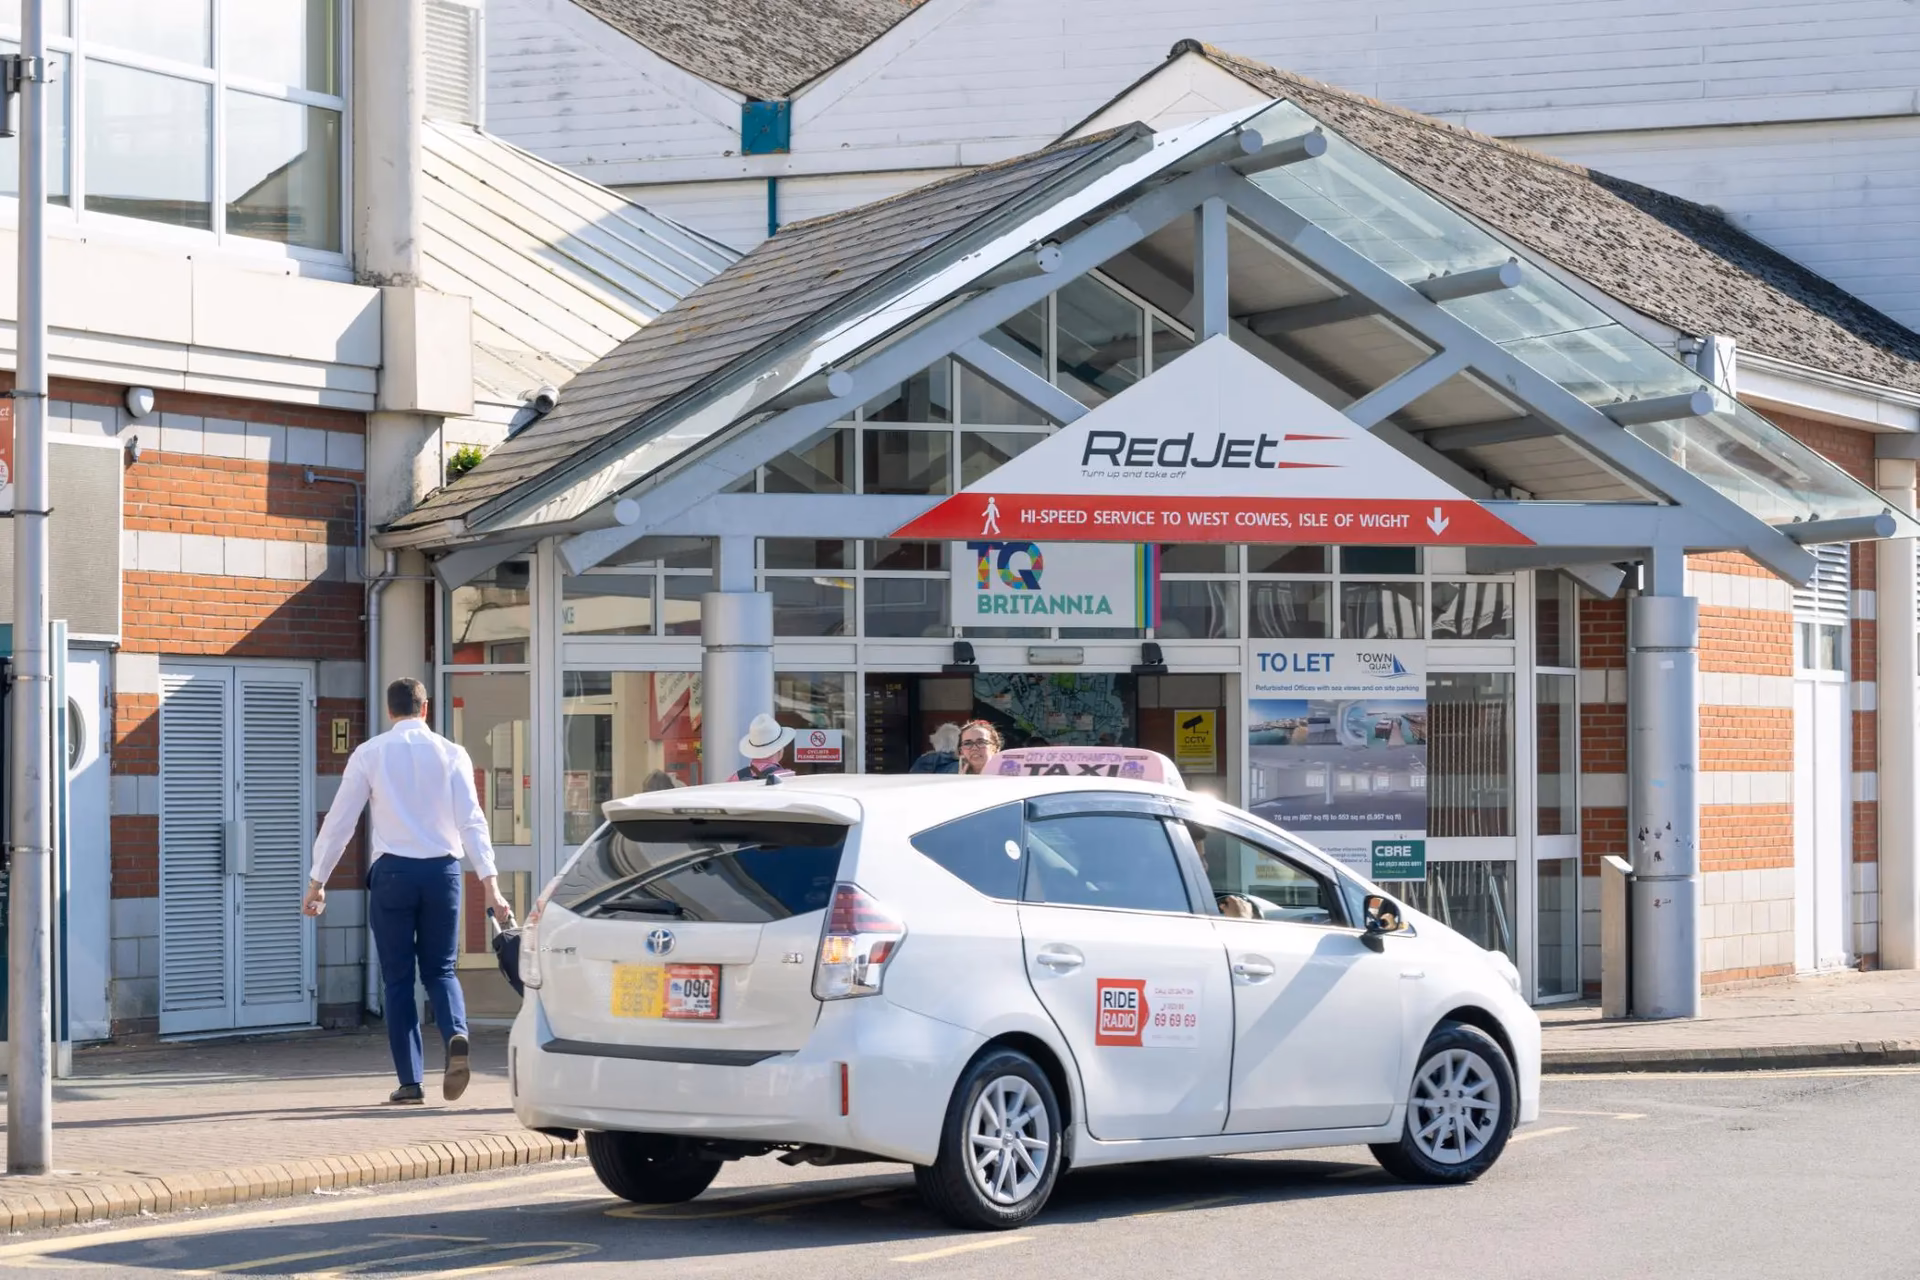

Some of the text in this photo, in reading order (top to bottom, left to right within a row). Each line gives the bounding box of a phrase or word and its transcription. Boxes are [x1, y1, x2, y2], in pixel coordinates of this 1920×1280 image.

[1081, 469, 1187, 479] Turn up and take off
[1020, 509, 1411, 529] HI-SPEED SERVICE TO WEST COWES, ISLE OF WIGHT
[966, 541, 1044, 590] TQ
[977, 593, 1114, 615] BRITANNIA
[1257, 652, 1335, 672] TO LET
[1356, 653, 1392, 663] TOWN
[1368, 663, 1392, 671] QUAY
[1184, 735, 1206, 744] CCTV
[1025, 752, 1045, 762] CITY
[1046, 752, 1058, 762] OF
[1059, 752, 1122, 763] SOUTHAMPTON
[1024, 763, 1120, 778] TAXI
[1375, 845, 1412, 857] CBRE
[683, 979, 711, 999] 090
[1103, 990, 1137, 1009] RIDE
[1103, 1012, 1136, 1029] RADIO
[1154, 1013, 1196, 1027] 69 69 69
